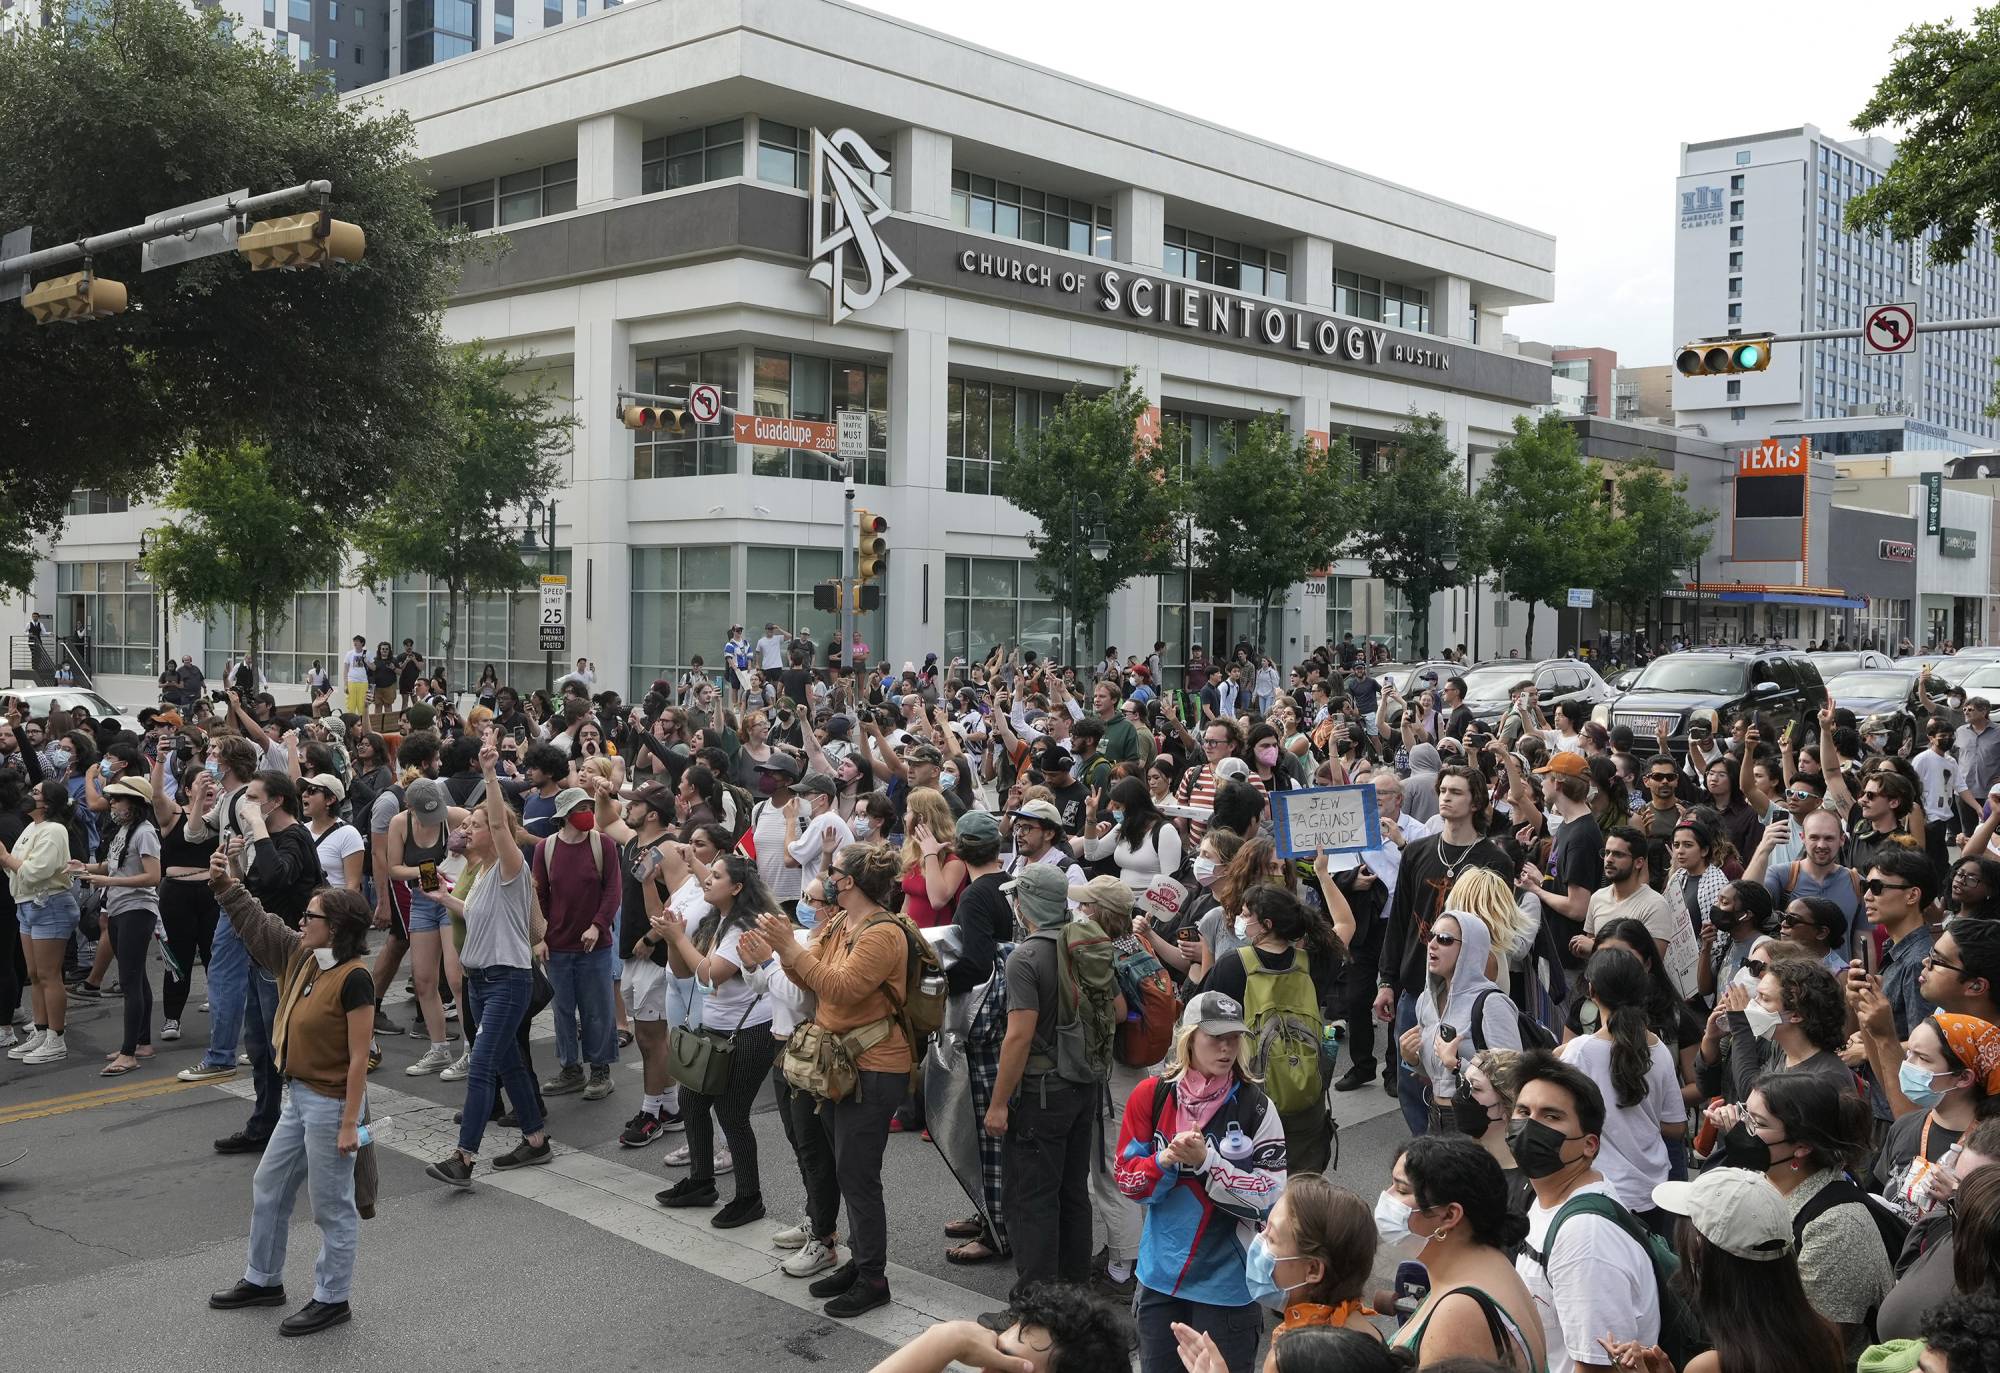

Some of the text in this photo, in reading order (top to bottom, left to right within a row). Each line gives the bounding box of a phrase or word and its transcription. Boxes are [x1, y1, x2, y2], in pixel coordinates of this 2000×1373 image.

[1681, 211, 1723, 222] AMERICAN
[1681, 219, 1723, 229] CAMPUS
[960, 250, 1449, 370] CHURCH OF SCIENTOLOGY AUSTIN
[754, 418, 836, 446] Guadalupe ST
[843, 430, 862, 440] MUST
[816, 437, 836, 449] 2200
[1741, 445, 1801, 469] TEXAS
[1929, 475, 1940, 532] sweetgreen
[1891, 545, 1916, 558] CHIPOTLE
[543, 587, 563, 595] SPEED
[1305, 582, 1326, 594] 2200
[543, 608, 562, 624] 25
[543, 627, 562, 635] UNLESS
[543, 641, 562, 649] POSTED
[1309, 796, 1340, 811] JEW
[1295, 811, 1356, 829] AGAINST
[1294, 828, 1359, 848] GENOCIDE
[1150, 893, 1177, 912] TANGO
